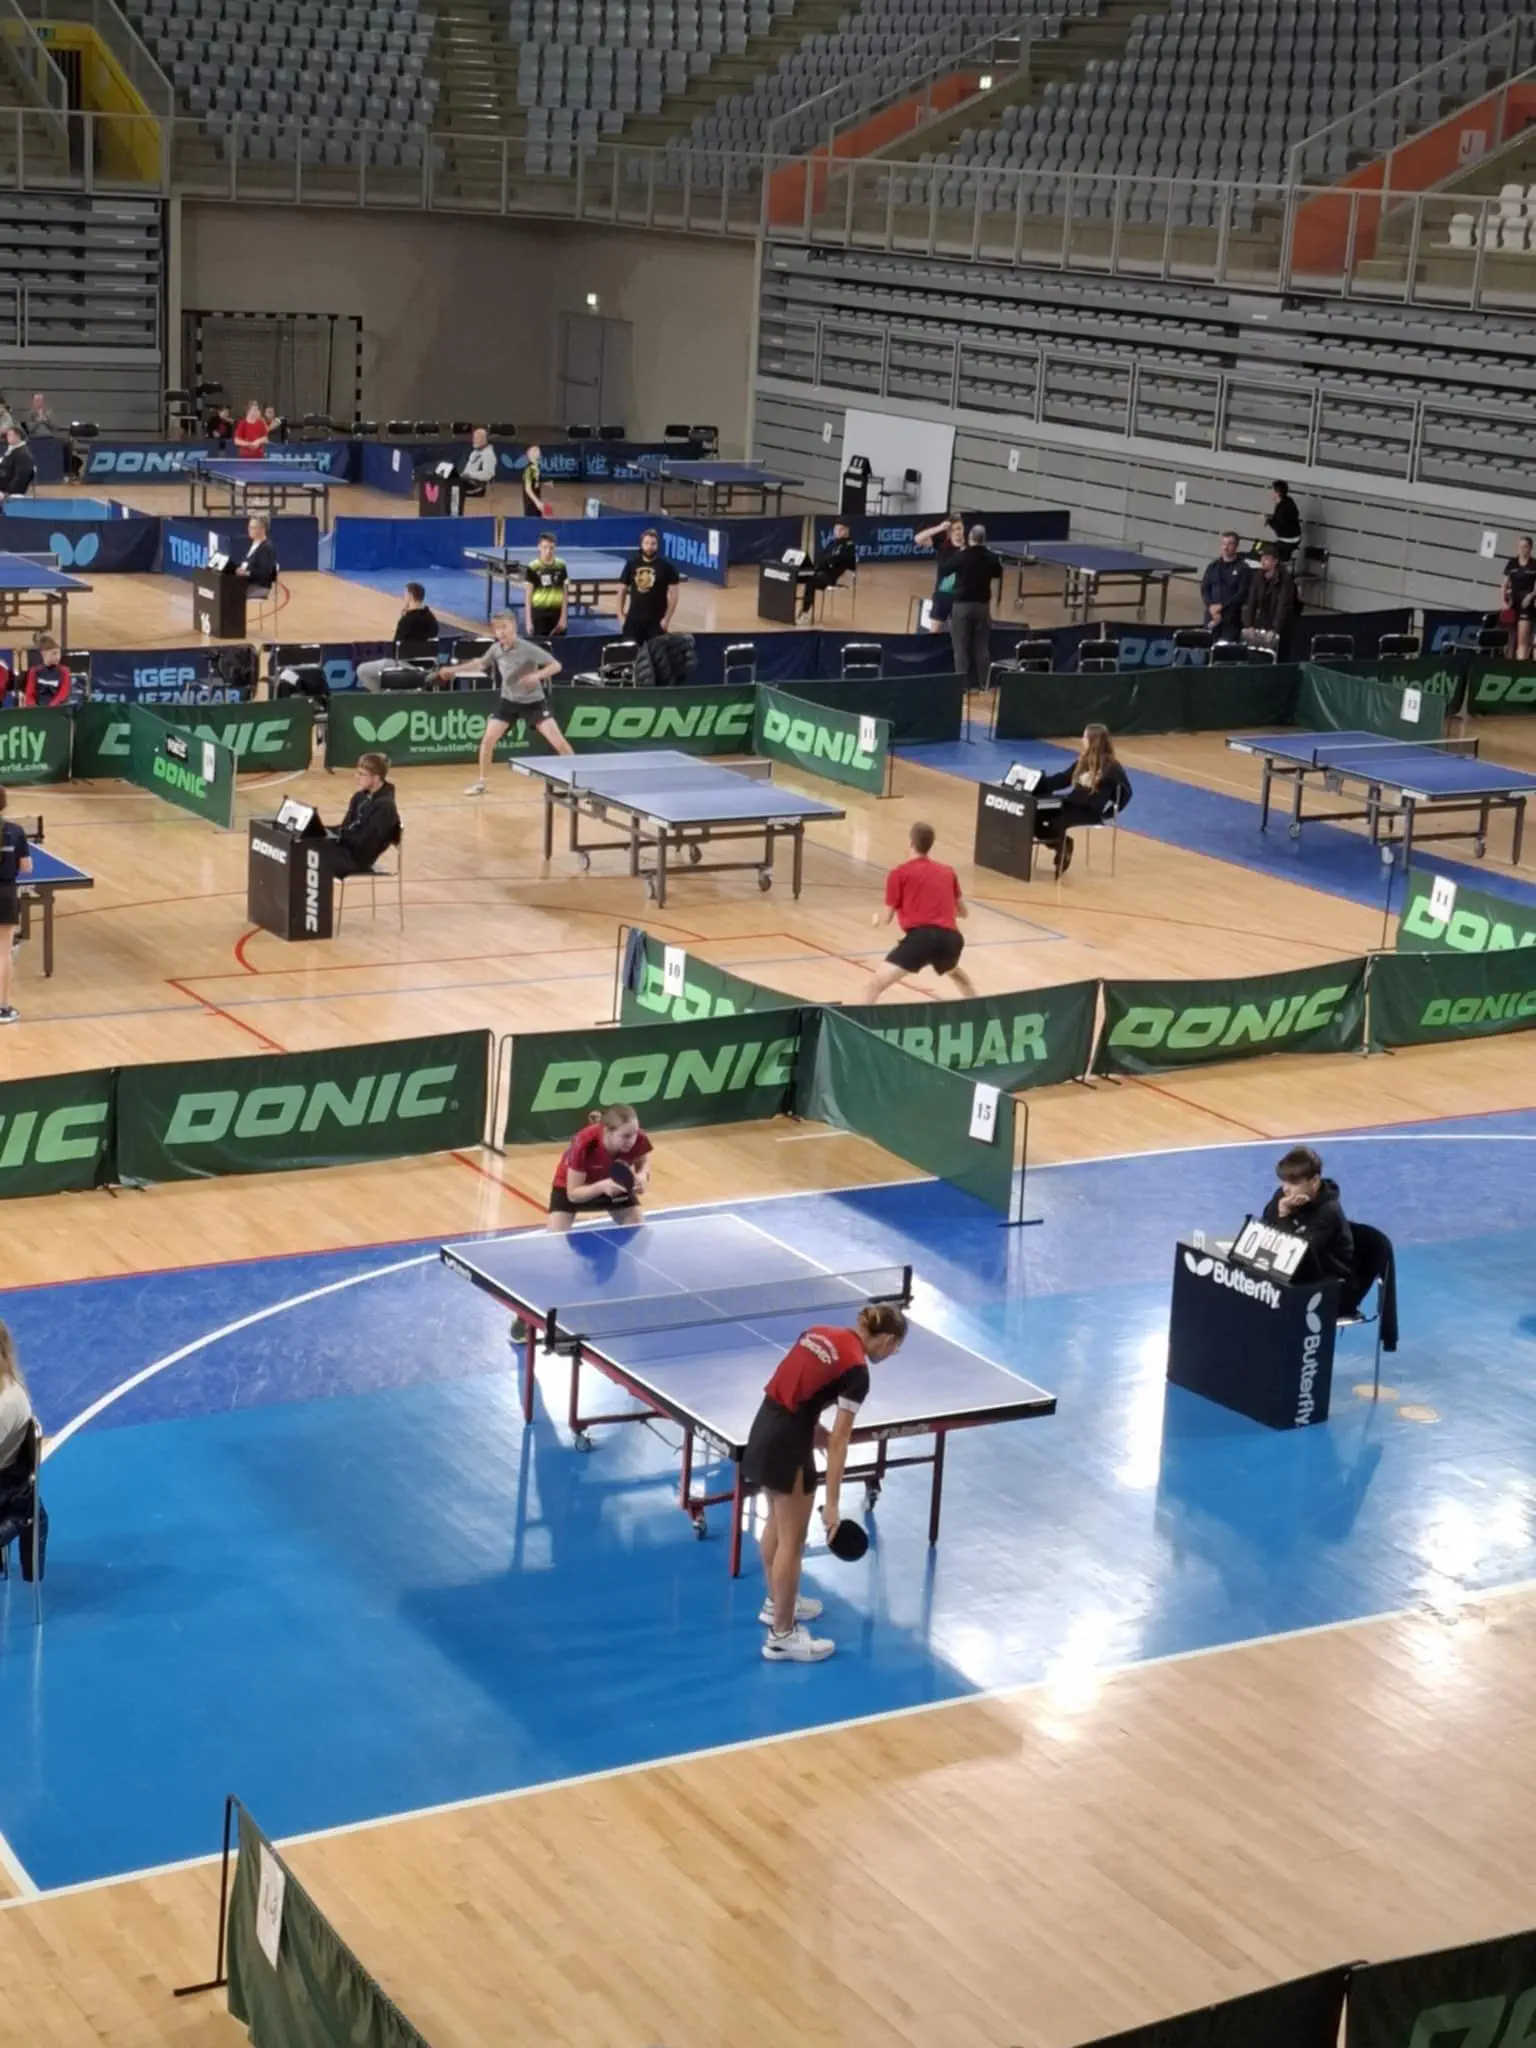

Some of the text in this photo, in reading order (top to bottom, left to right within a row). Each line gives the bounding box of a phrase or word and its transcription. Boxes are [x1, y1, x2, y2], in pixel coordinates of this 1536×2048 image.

[565, 704, 754, 738] DONIC
[153, 757, 207, 798] DONIC
[985, 794, 1025, 817] DONIC
[252, 838, 287, 864] DONIC
[306, 850, 319, 933] DONIC
[1108, 985, 1348, 1049] DONIC
[531, 1037, 799, 1112] DONIC
[164, 1065, 457, 1145] DONIC
[1213, 1261, 1281, 1308] Butterfly
[1295, 1335, 1321, 1425] Butterfly
